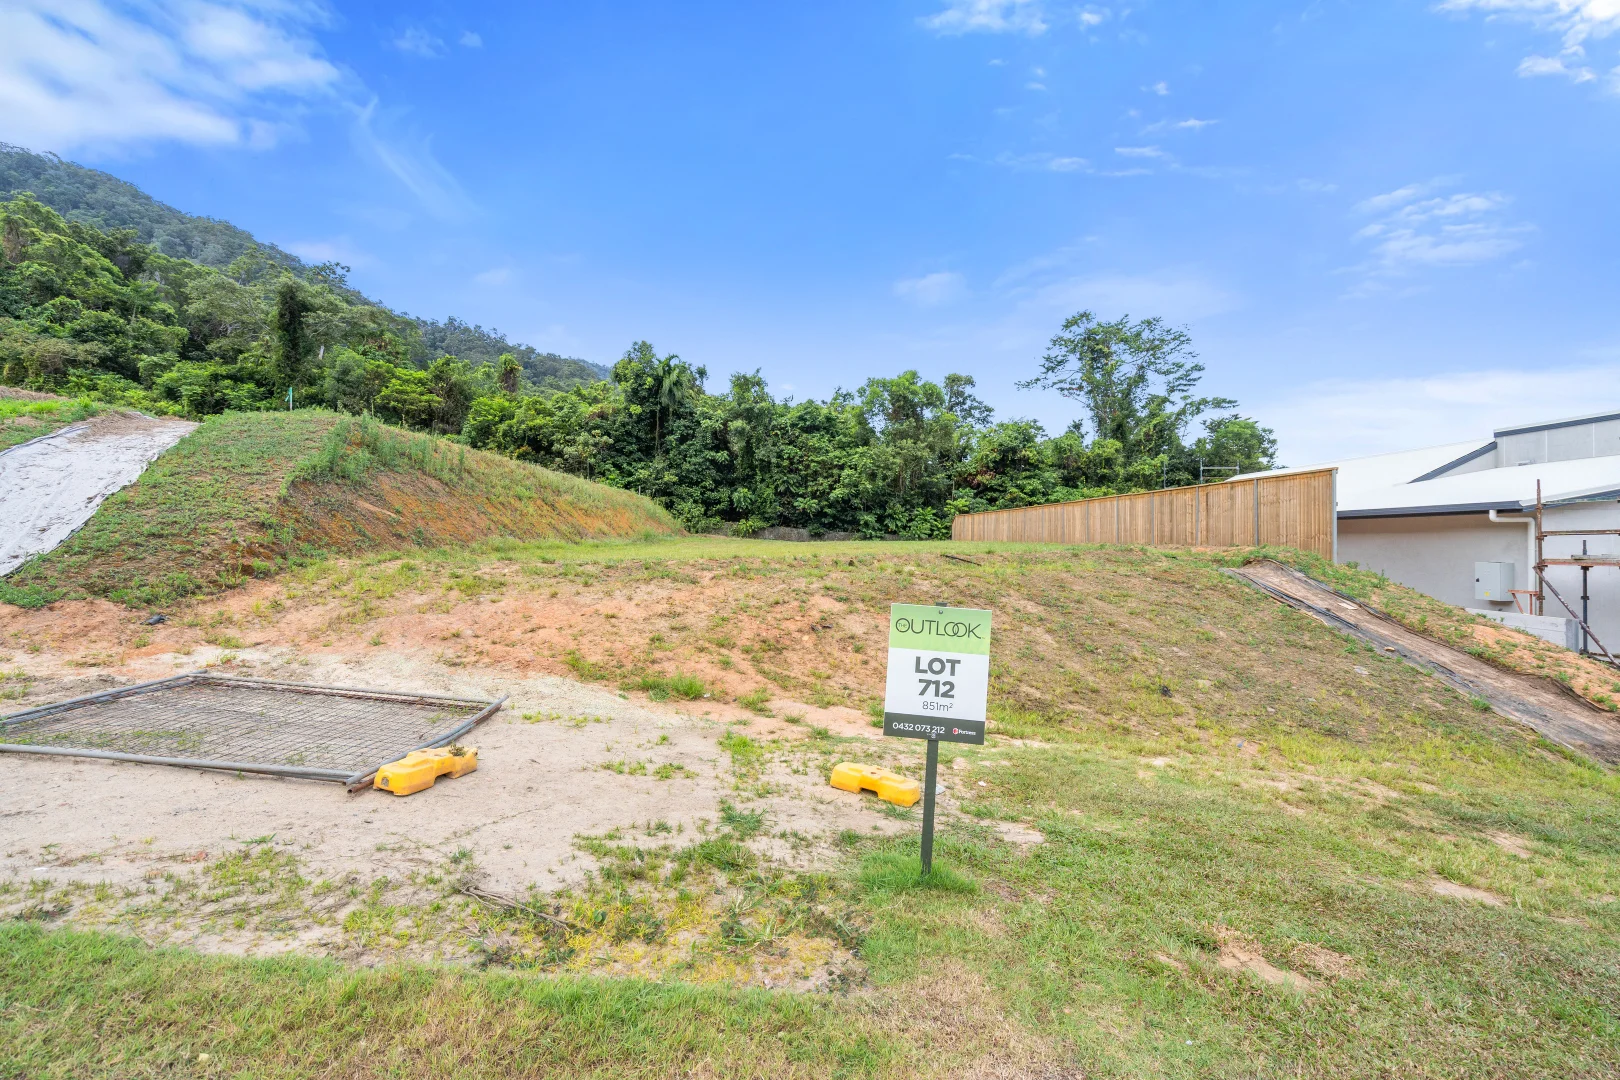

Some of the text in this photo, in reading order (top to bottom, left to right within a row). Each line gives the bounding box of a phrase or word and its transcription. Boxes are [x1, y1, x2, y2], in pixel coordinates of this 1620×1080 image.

[895, 617, 982, 639] OUTLOOK
[915, 656, 961, 677] LOT
[918, 678, 955, 699] 712
[922, 701, 954, 712] 851m²
[892, 722, 946, 734] 0432 073 212
